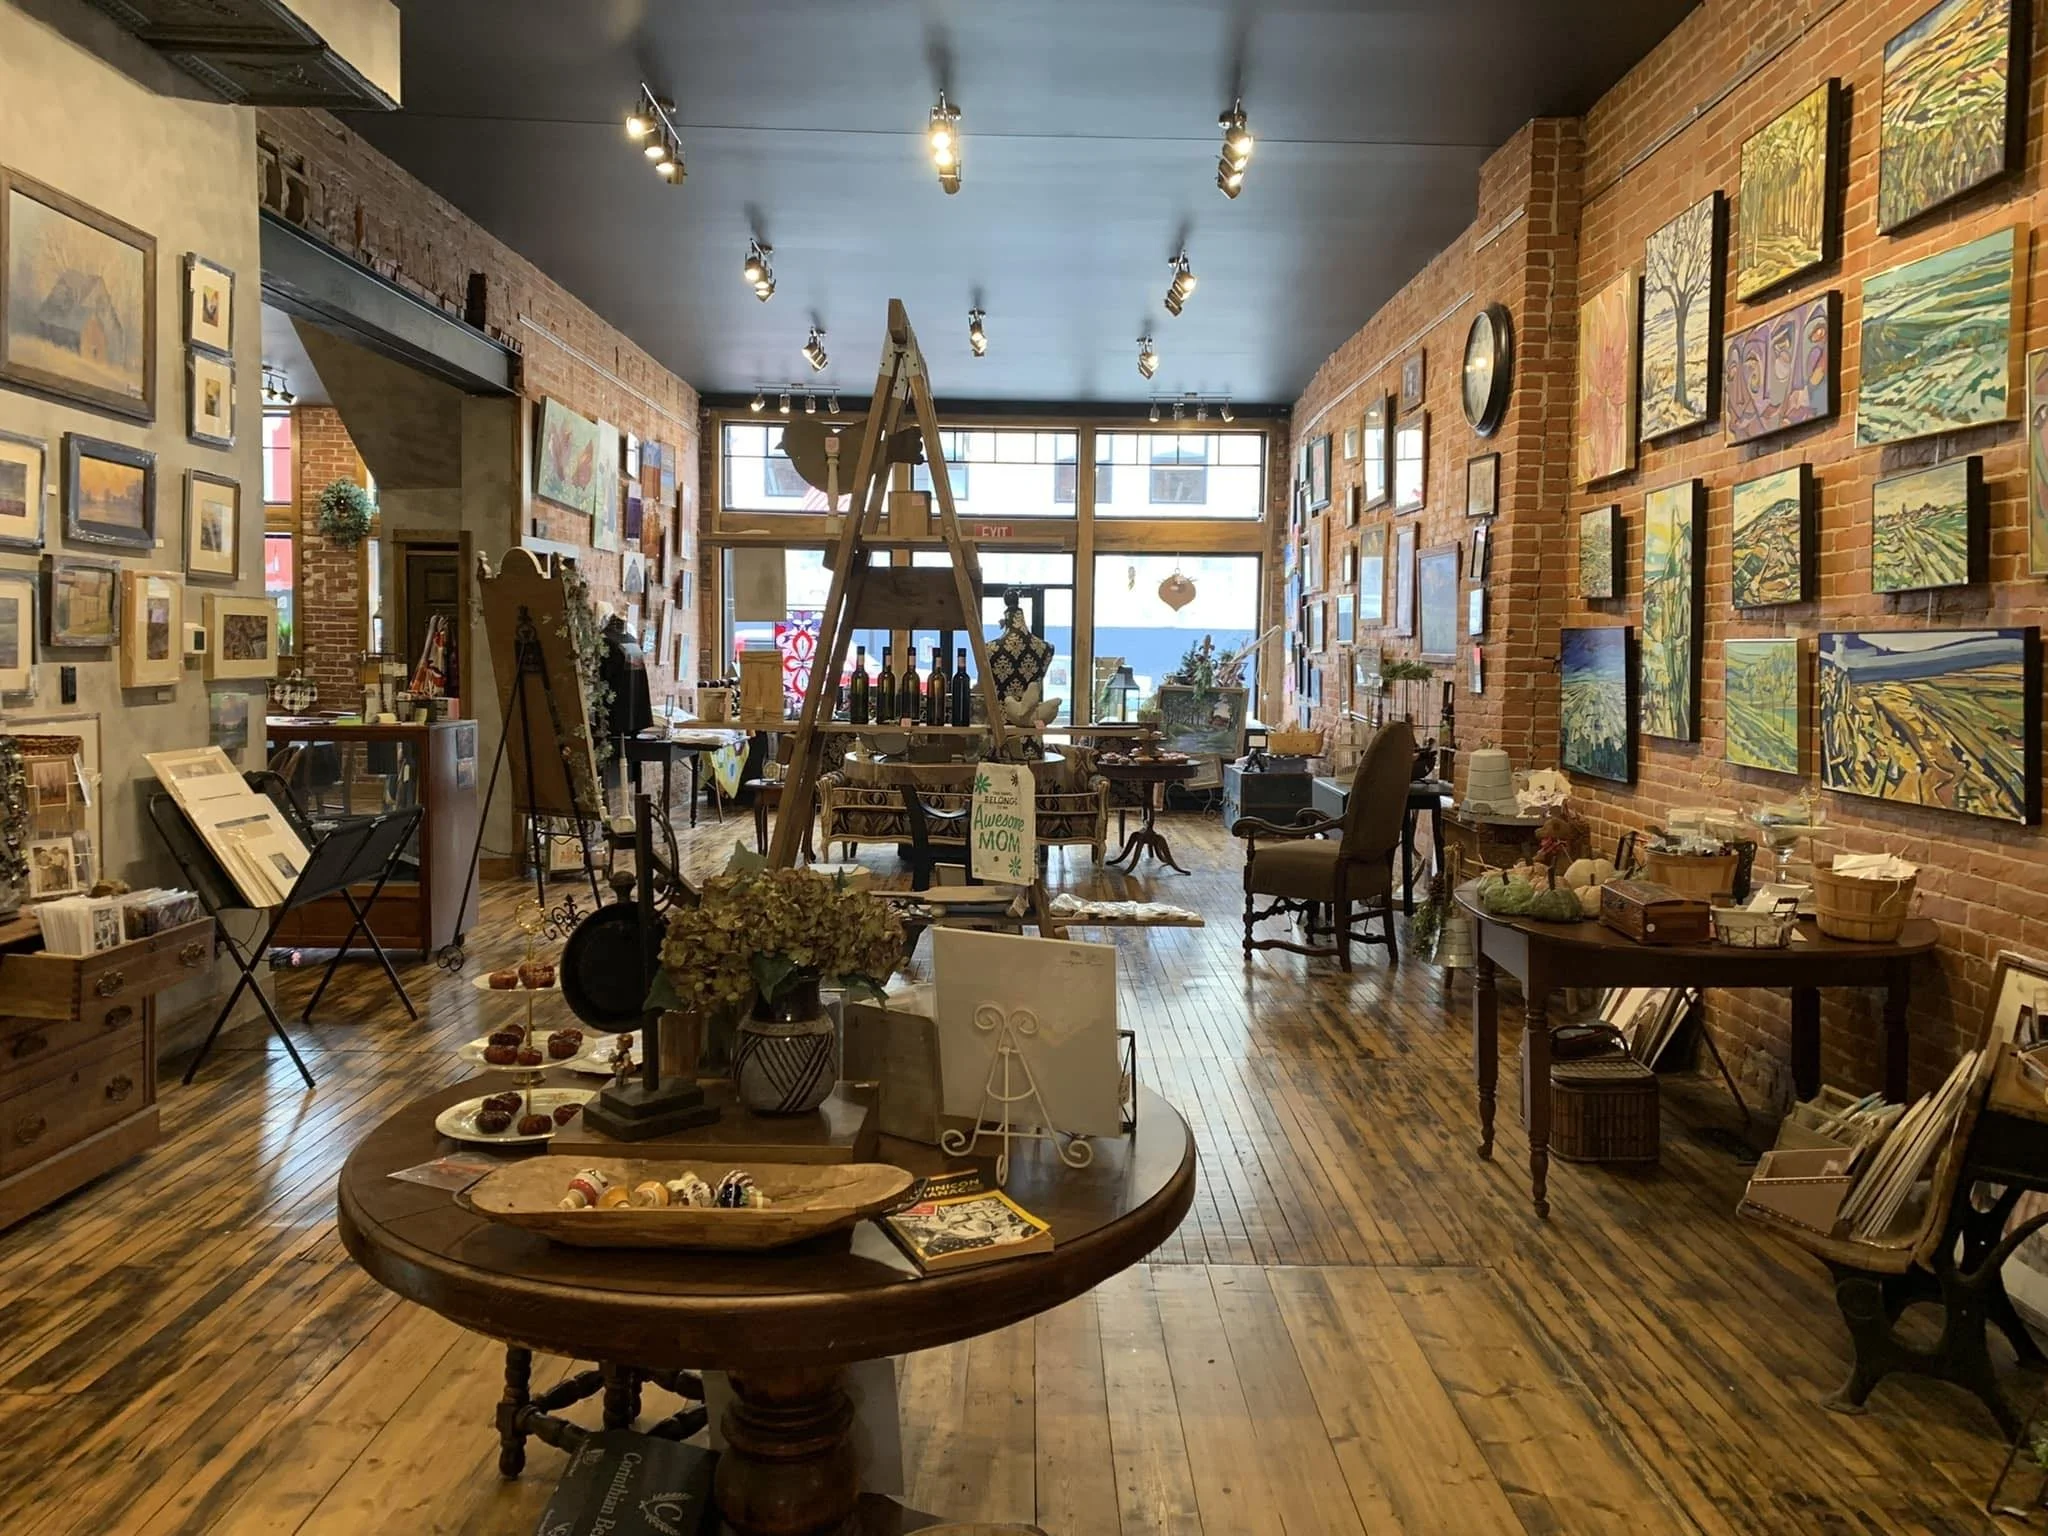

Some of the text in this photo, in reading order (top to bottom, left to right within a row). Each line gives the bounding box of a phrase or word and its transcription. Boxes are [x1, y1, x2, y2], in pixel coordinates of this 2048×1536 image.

[982, 526, 1009, 537] EXIT
[973, 804, 1025, 832] Awesome
[978, 829, 1020, 854] MOM
[600, 1452, 642, 1514] Corinthian
